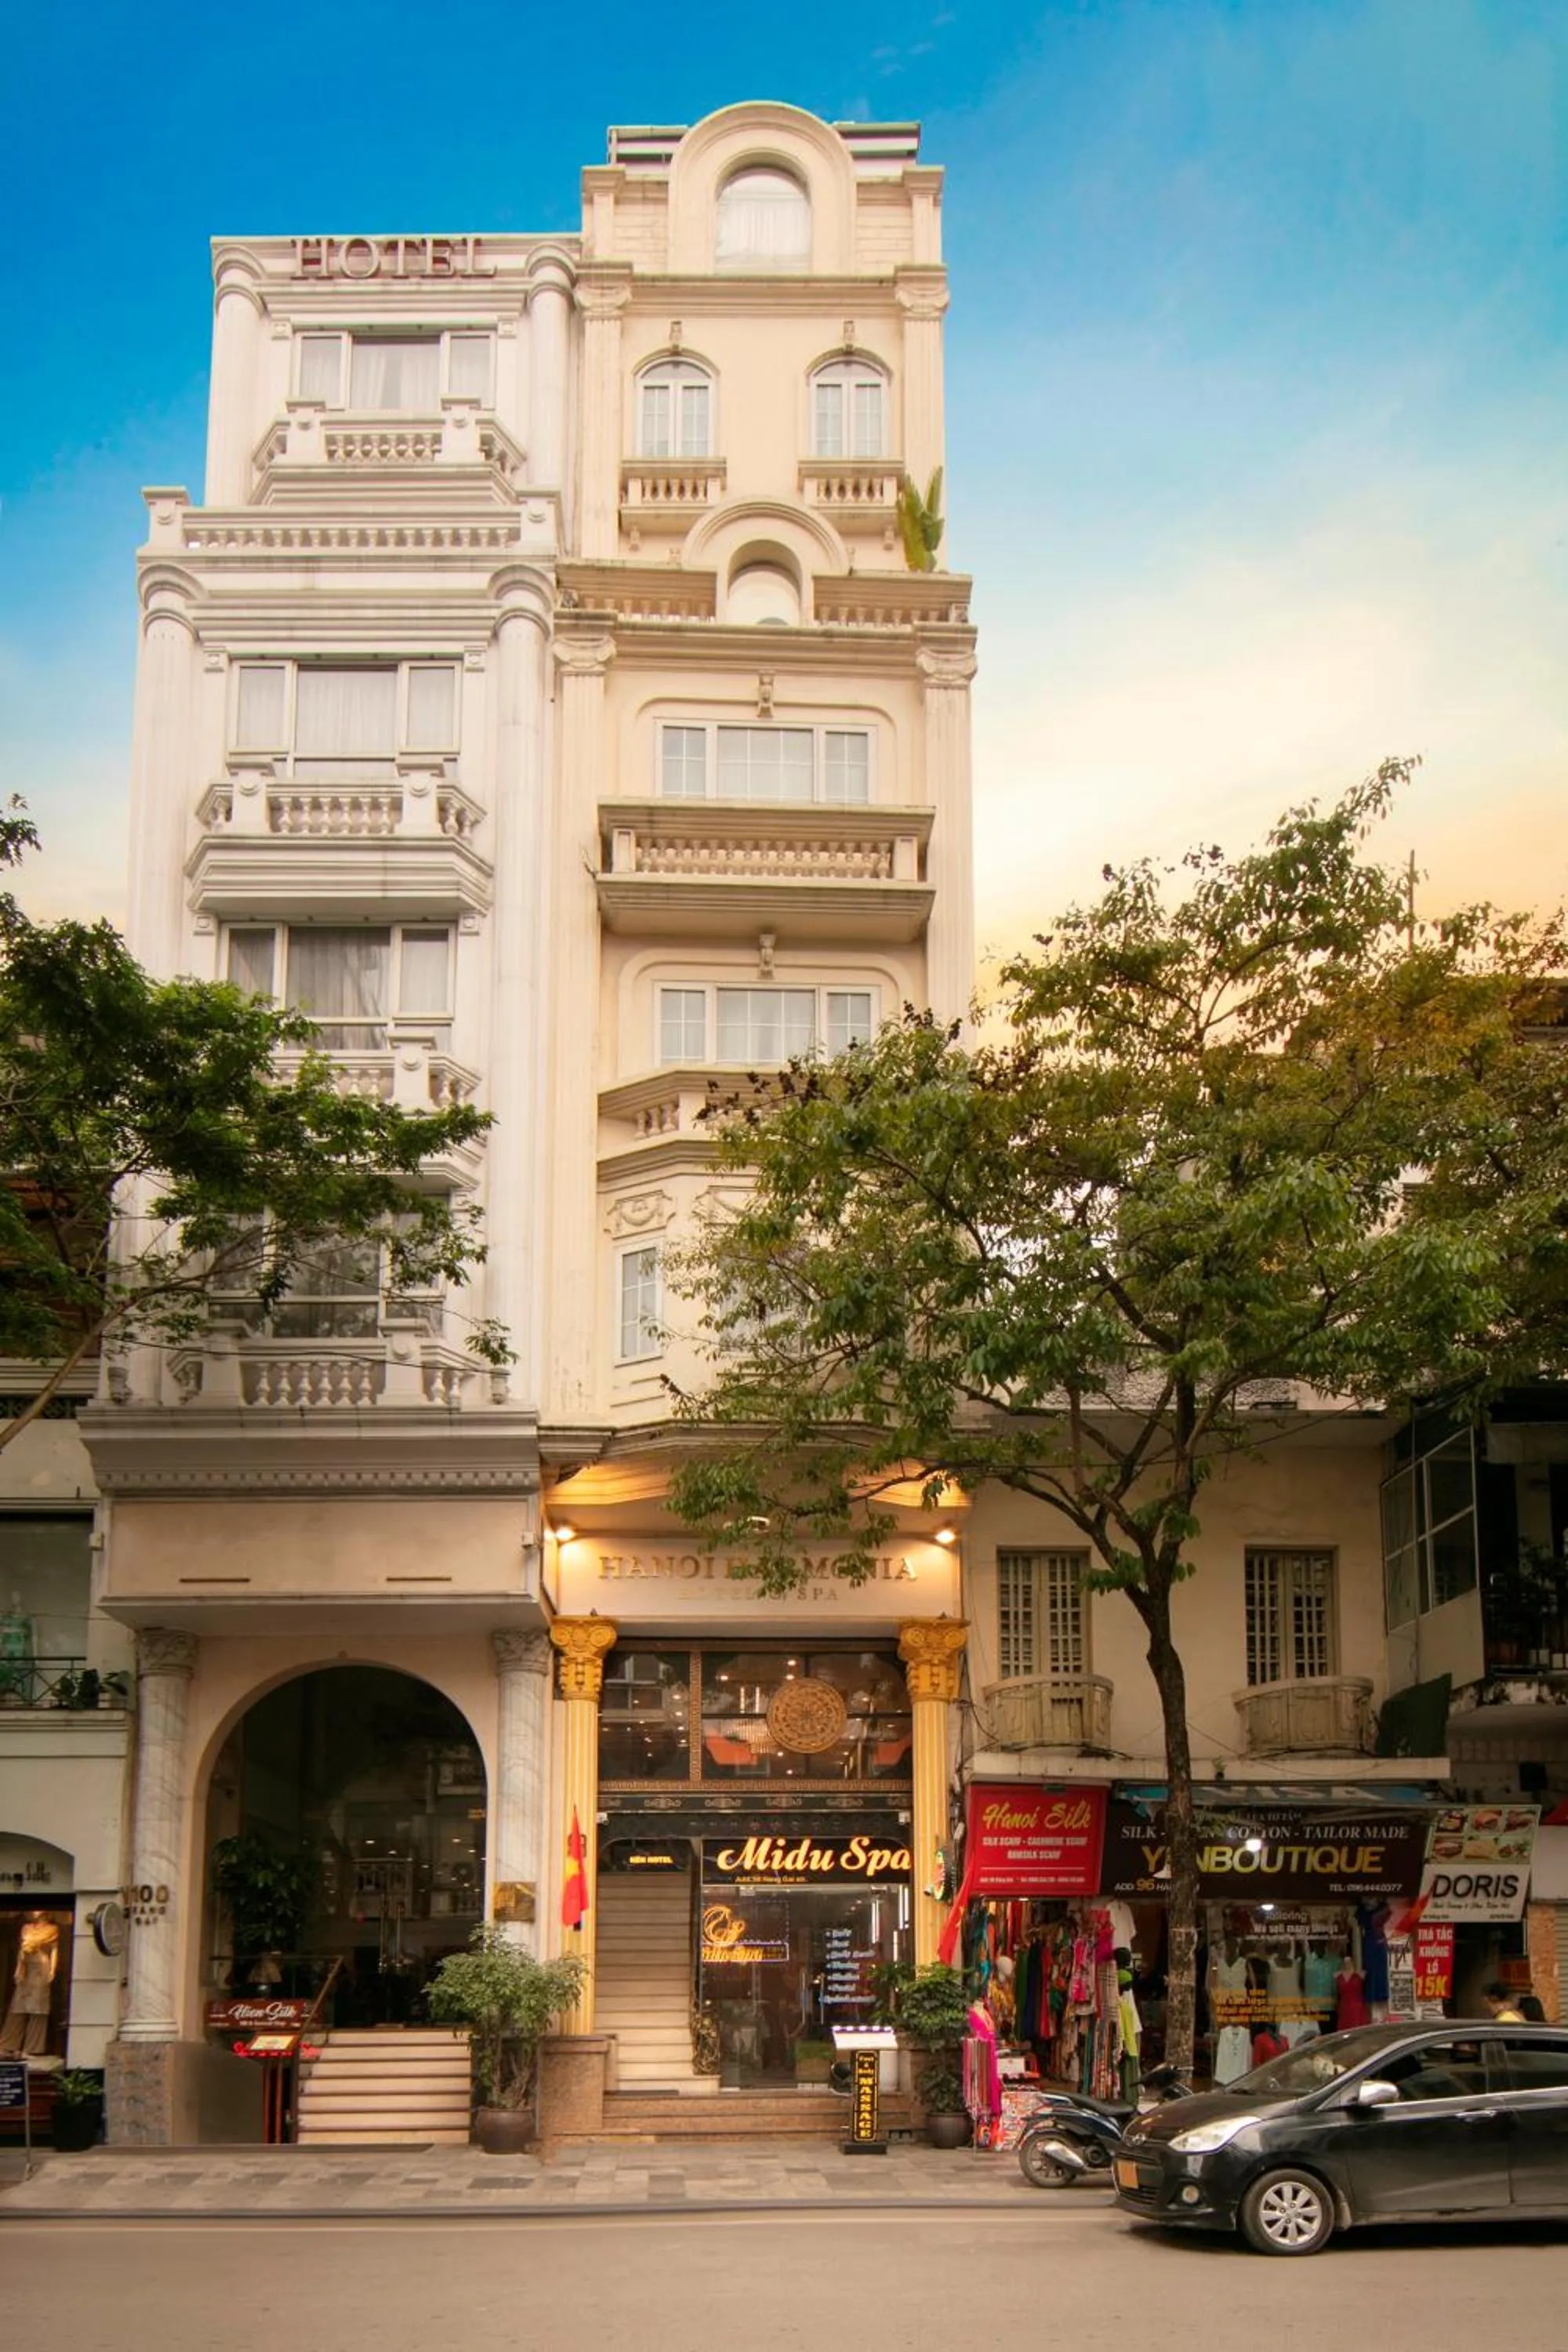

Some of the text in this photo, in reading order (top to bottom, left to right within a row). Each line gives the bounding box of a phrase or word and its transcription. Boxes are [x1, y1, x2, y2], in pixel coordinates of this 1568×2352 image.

[290, 238, 497, 279] HOTEL
[598, 1555, 916, 1580] HANOI HMONIA
[797, 1587, 839, 1600] SPA
[982, 1798, 1091, 1830] Hanoi Silk
[1121, 1825, 1157, 1838] SILK
[1304, 1826, 1361, 1838] TAILOR
[1363, 1826, 1410, 1838] MADE
[717, 1837, 911, 1876] Midu Spa
[1142, 1846, 1386, 1874] YNBOUTIQUE
[1136, 1878, 1155, 1892] 96
[1432, 1874, 1519, 1898] DORIS
[1416, 1976, 1448, 1997] 15K
[858, 2078, 873, 2139] MASSAGE
